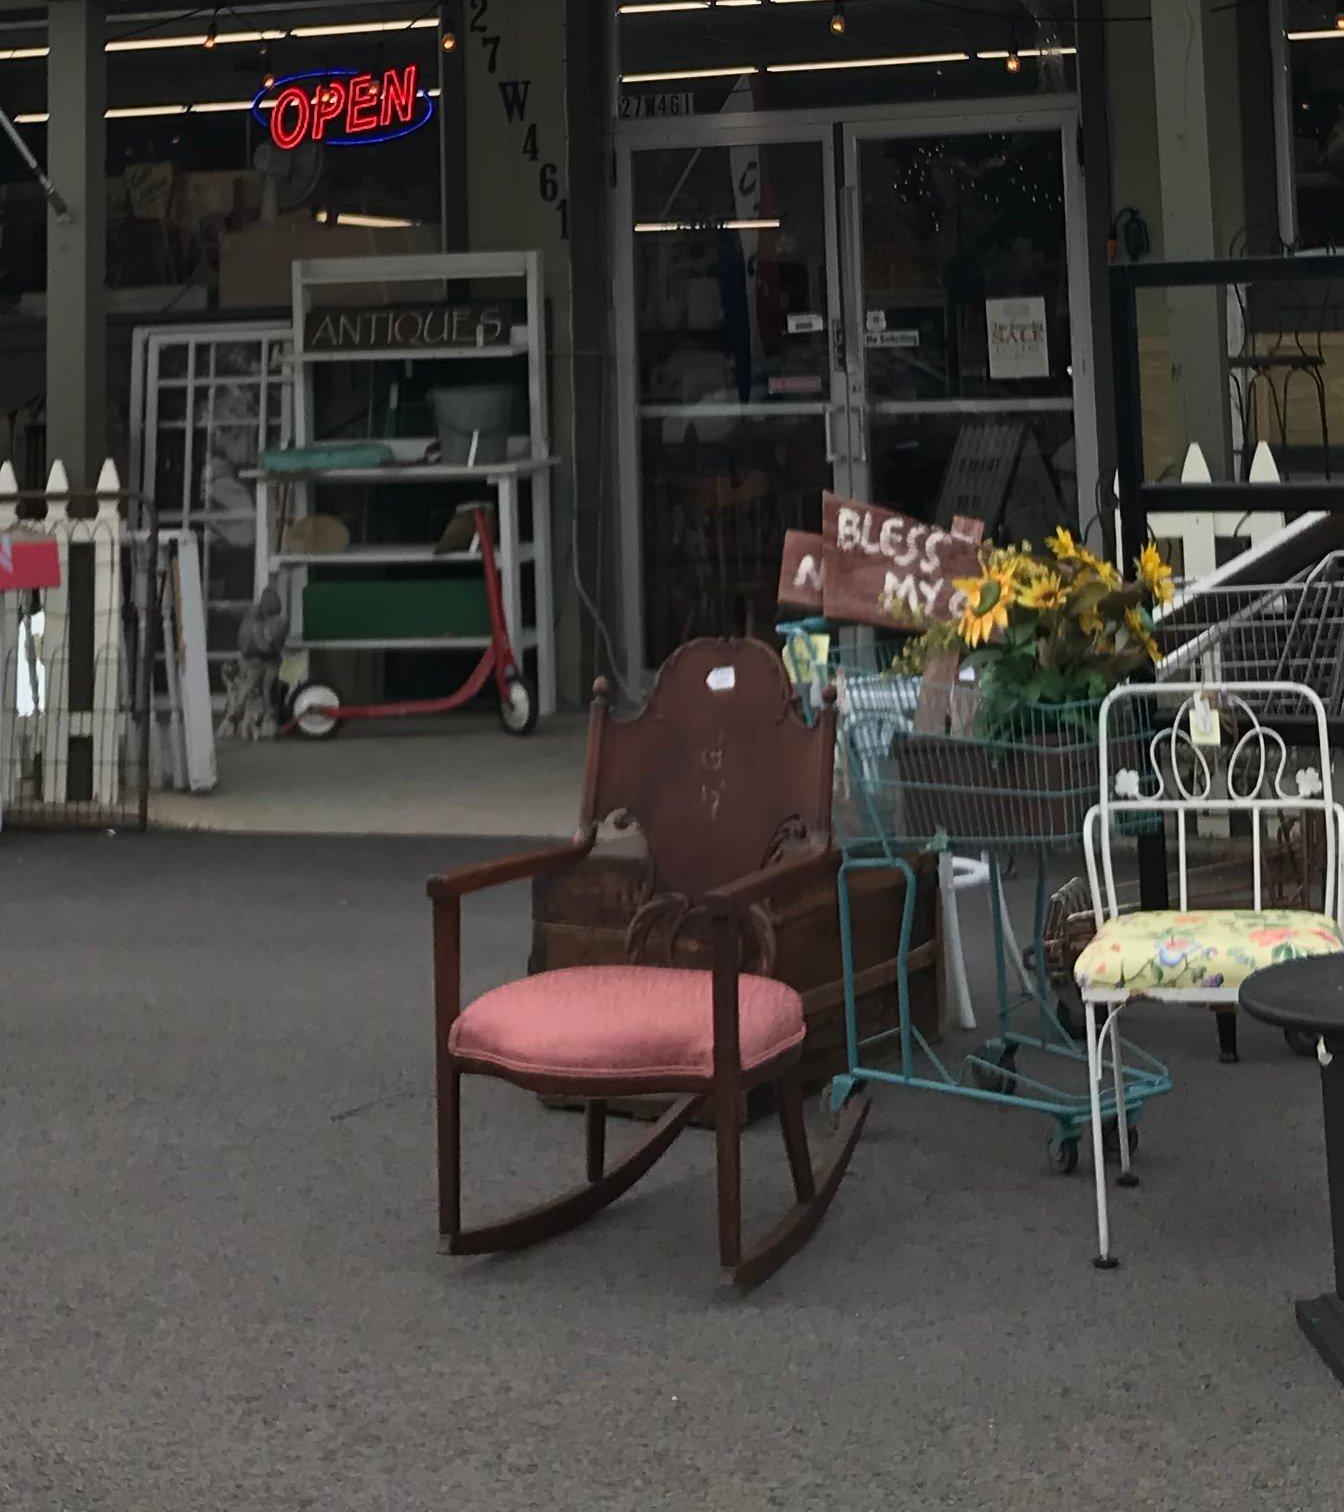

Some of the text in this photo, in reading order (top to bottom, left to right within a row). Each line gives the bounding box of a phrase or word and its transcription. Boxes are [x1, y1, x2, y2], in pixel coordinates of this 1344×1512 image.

[270, 62, 419, 150] OPEN
[621, 93, 691, 119] 27W461
[311, 308, 503, 347] ANTIQUES
[836, 506, 953, 574] BLESS
[883, 570, 945, 617] MY
